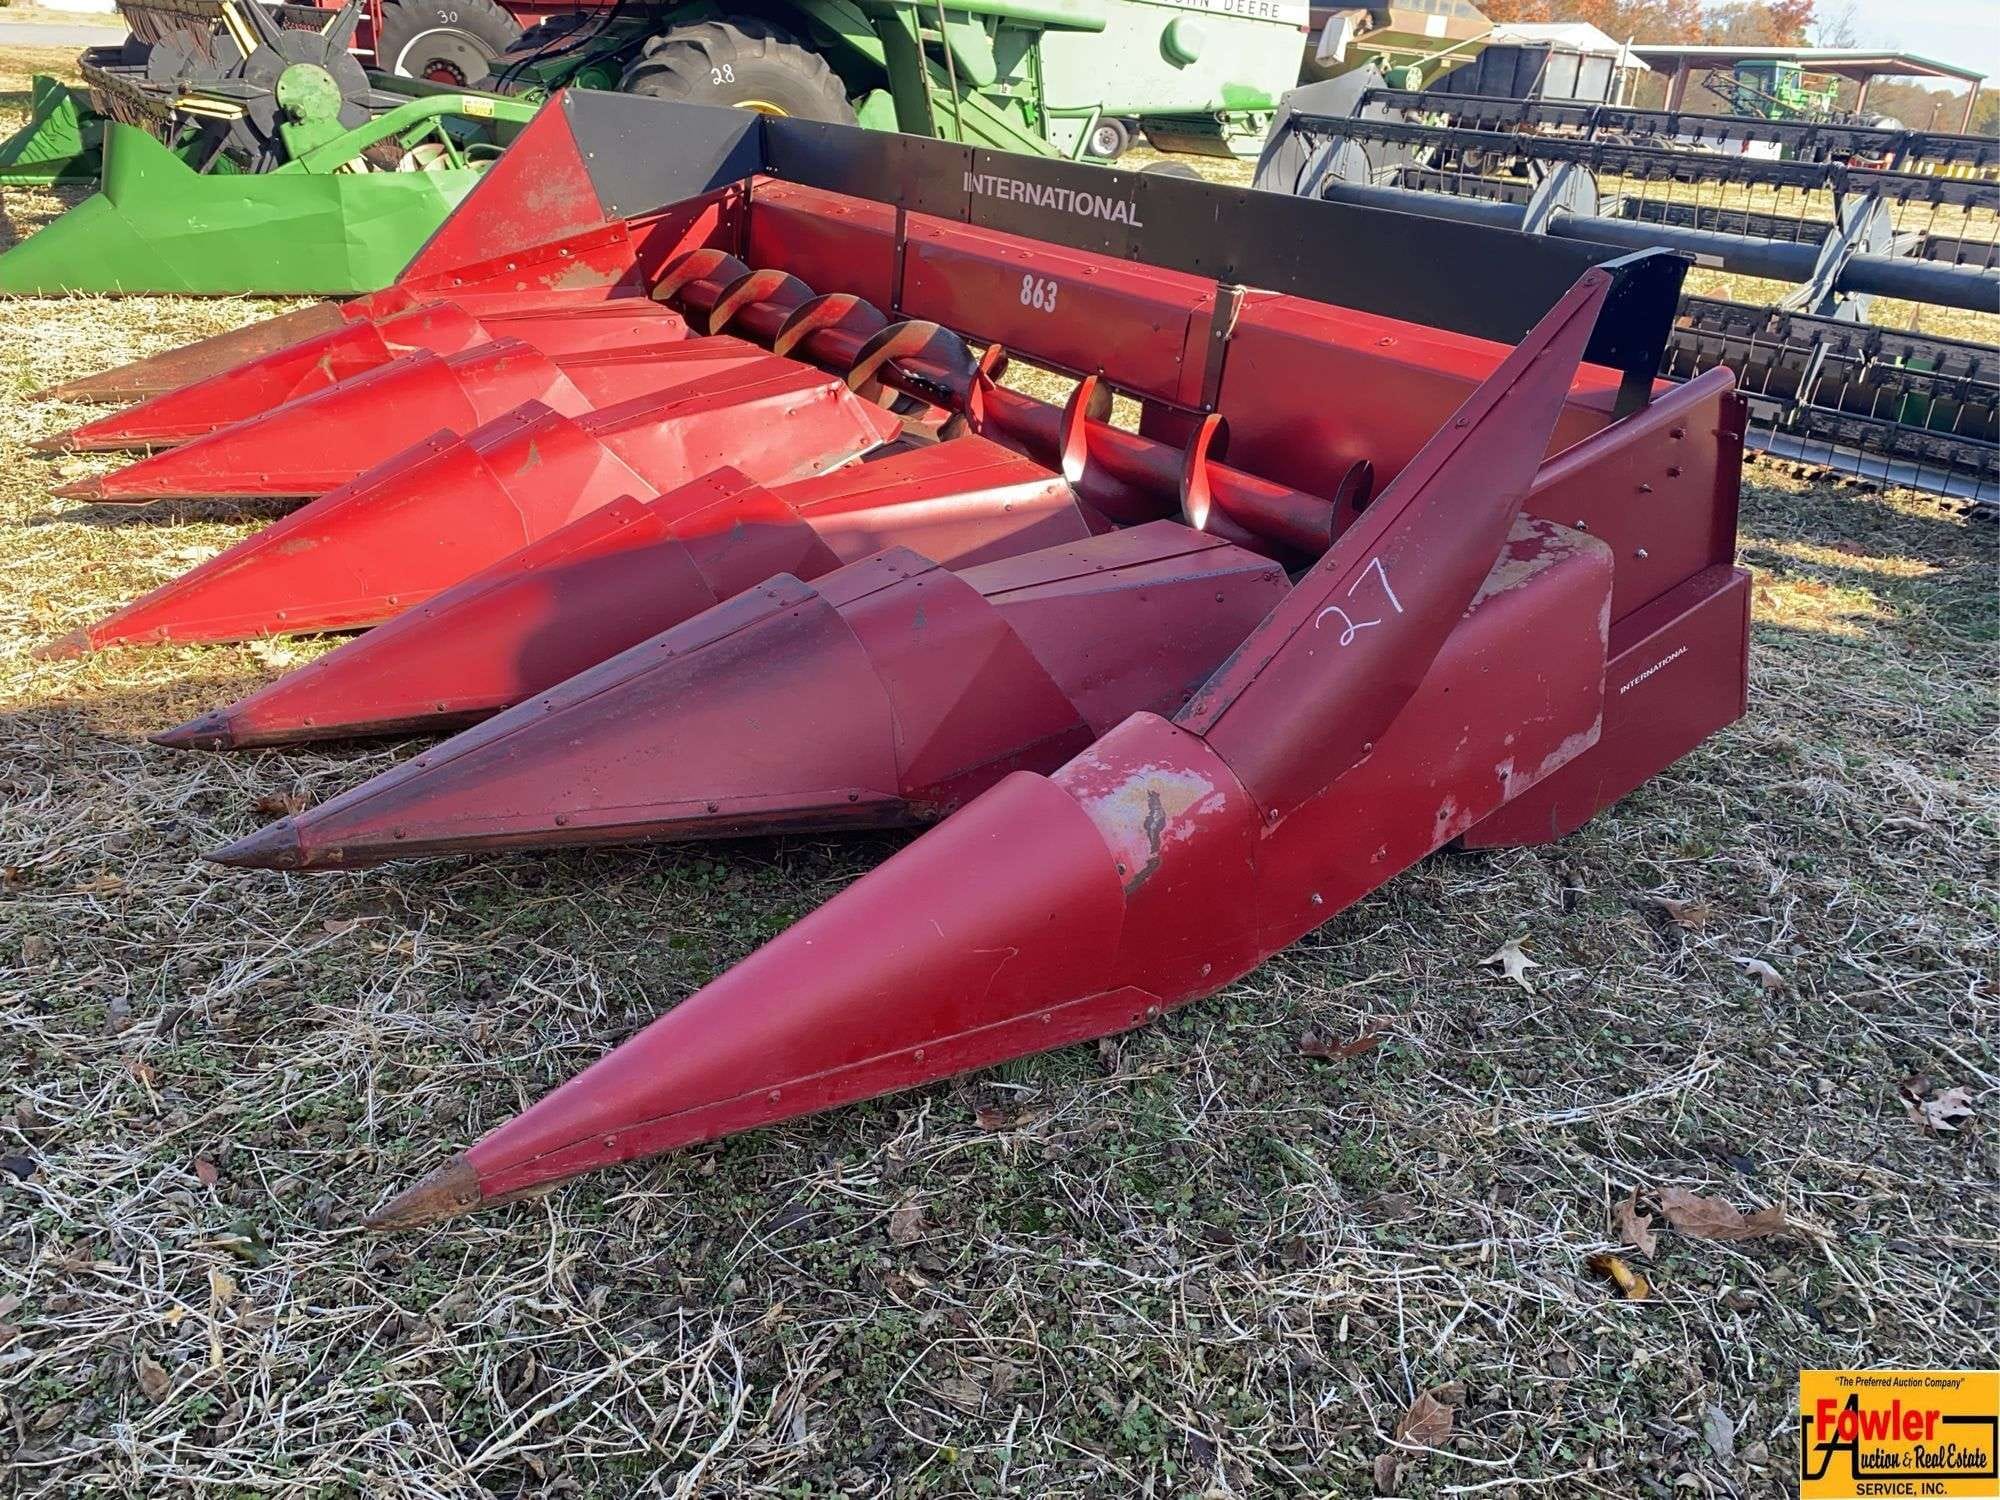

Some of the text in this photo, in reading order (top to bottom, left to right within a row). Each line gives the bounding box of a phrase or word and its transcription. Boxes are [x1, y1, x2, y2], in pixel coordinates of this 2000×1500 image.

[436, 10, 458, 24] 30
[1224, 0, 1280, 18] DEERE
[710, 64, 735, 85] 28
[963, 171, 1144, 228] INTERNATIONAL
[1020, 274, 1058, 313] 863
[1315, 557, 1404, 646] 27
[1620, 645, 1688, 694] INTERNATIONAL
